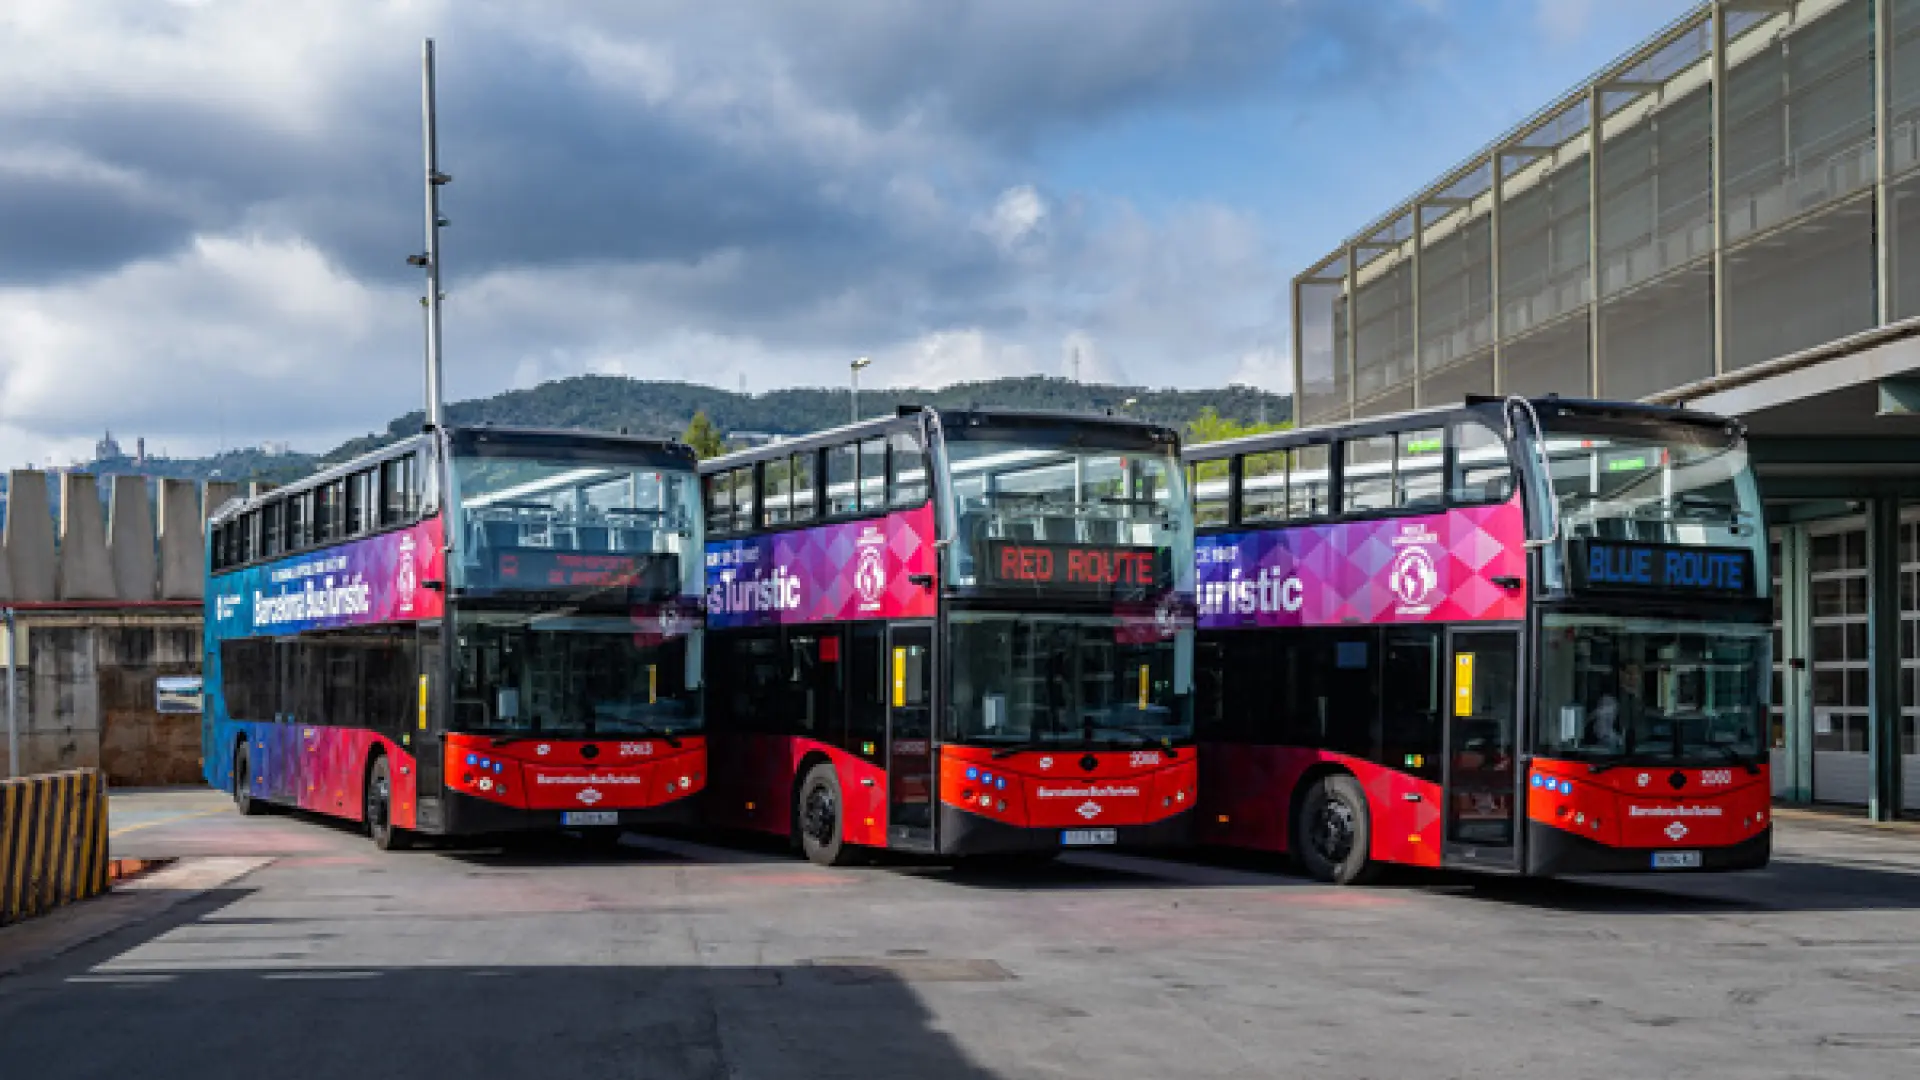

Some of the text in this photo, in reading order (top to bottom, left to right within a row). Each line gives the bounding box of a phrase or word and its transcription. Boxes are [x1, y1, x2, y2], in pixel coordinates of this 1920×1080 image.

[1001, 546, 1153, 584] RED ROUTE
[1588, 545, 1744, 589] BLUE ROUTE
[1196, 565, 1304, 614] urístic
